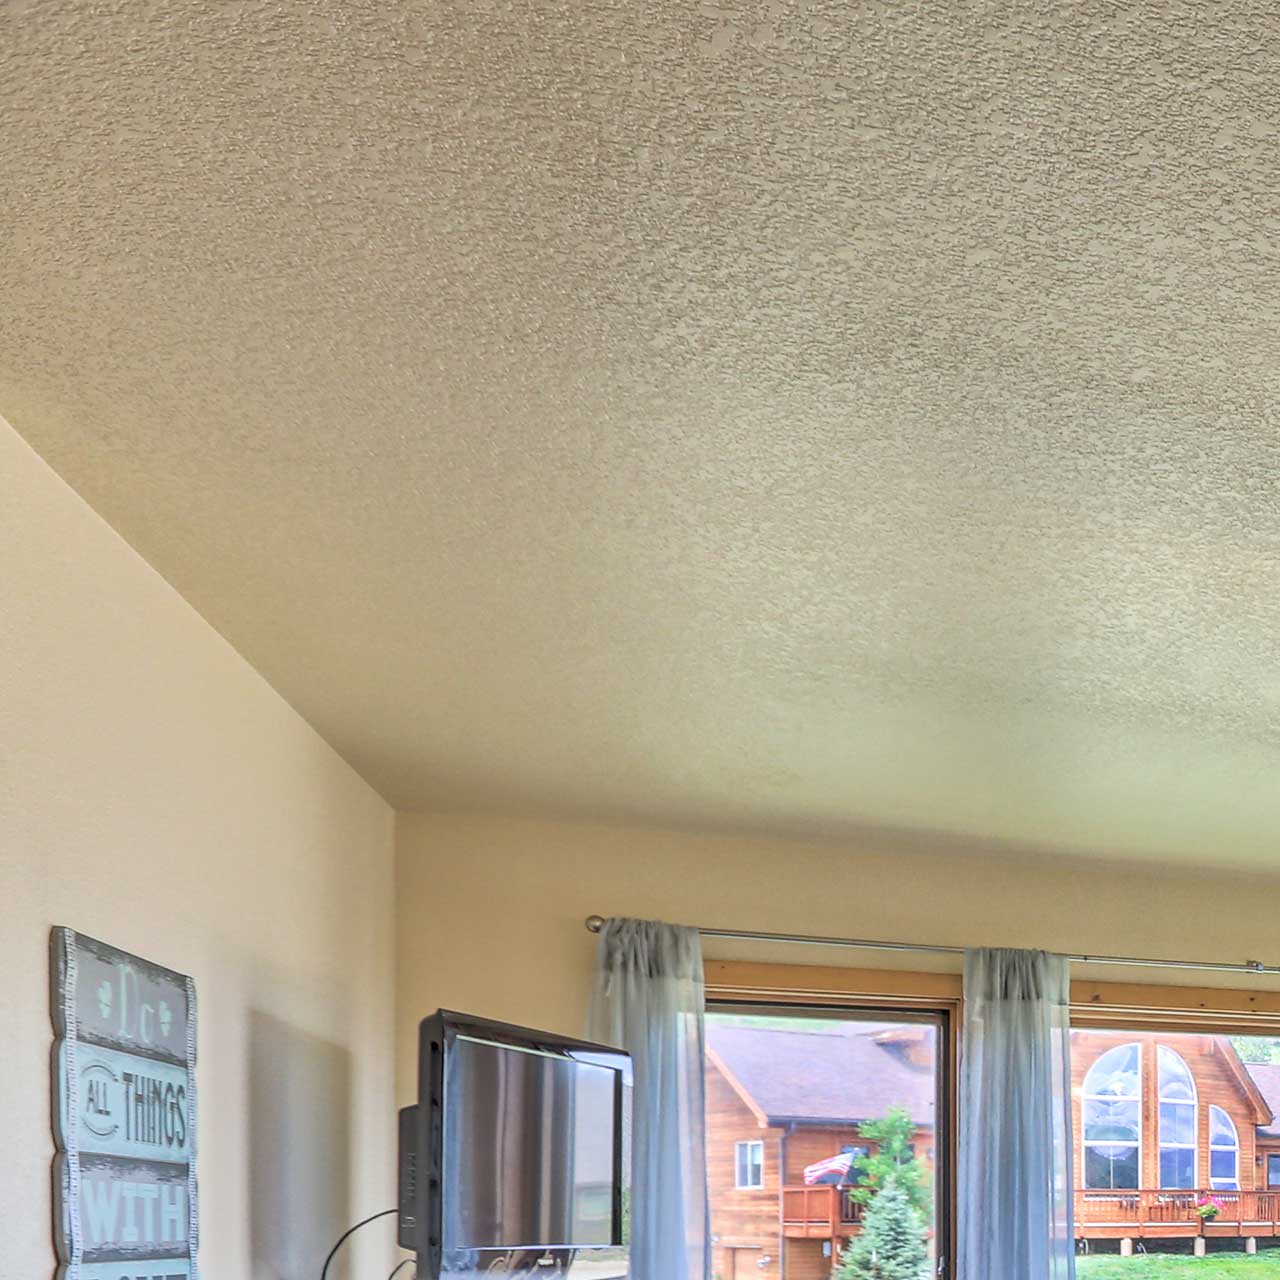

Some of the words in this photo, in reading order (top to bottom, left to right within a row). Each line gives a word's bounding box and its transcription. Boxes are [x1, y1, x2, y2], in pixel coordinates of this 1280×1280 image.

[117, 963, 155, 1043] Do
[87, 1080, 111, 1116] ALL
[123, 1072, 186, 1148] THINGS
[82, 1178, 186, 1243] WITH
